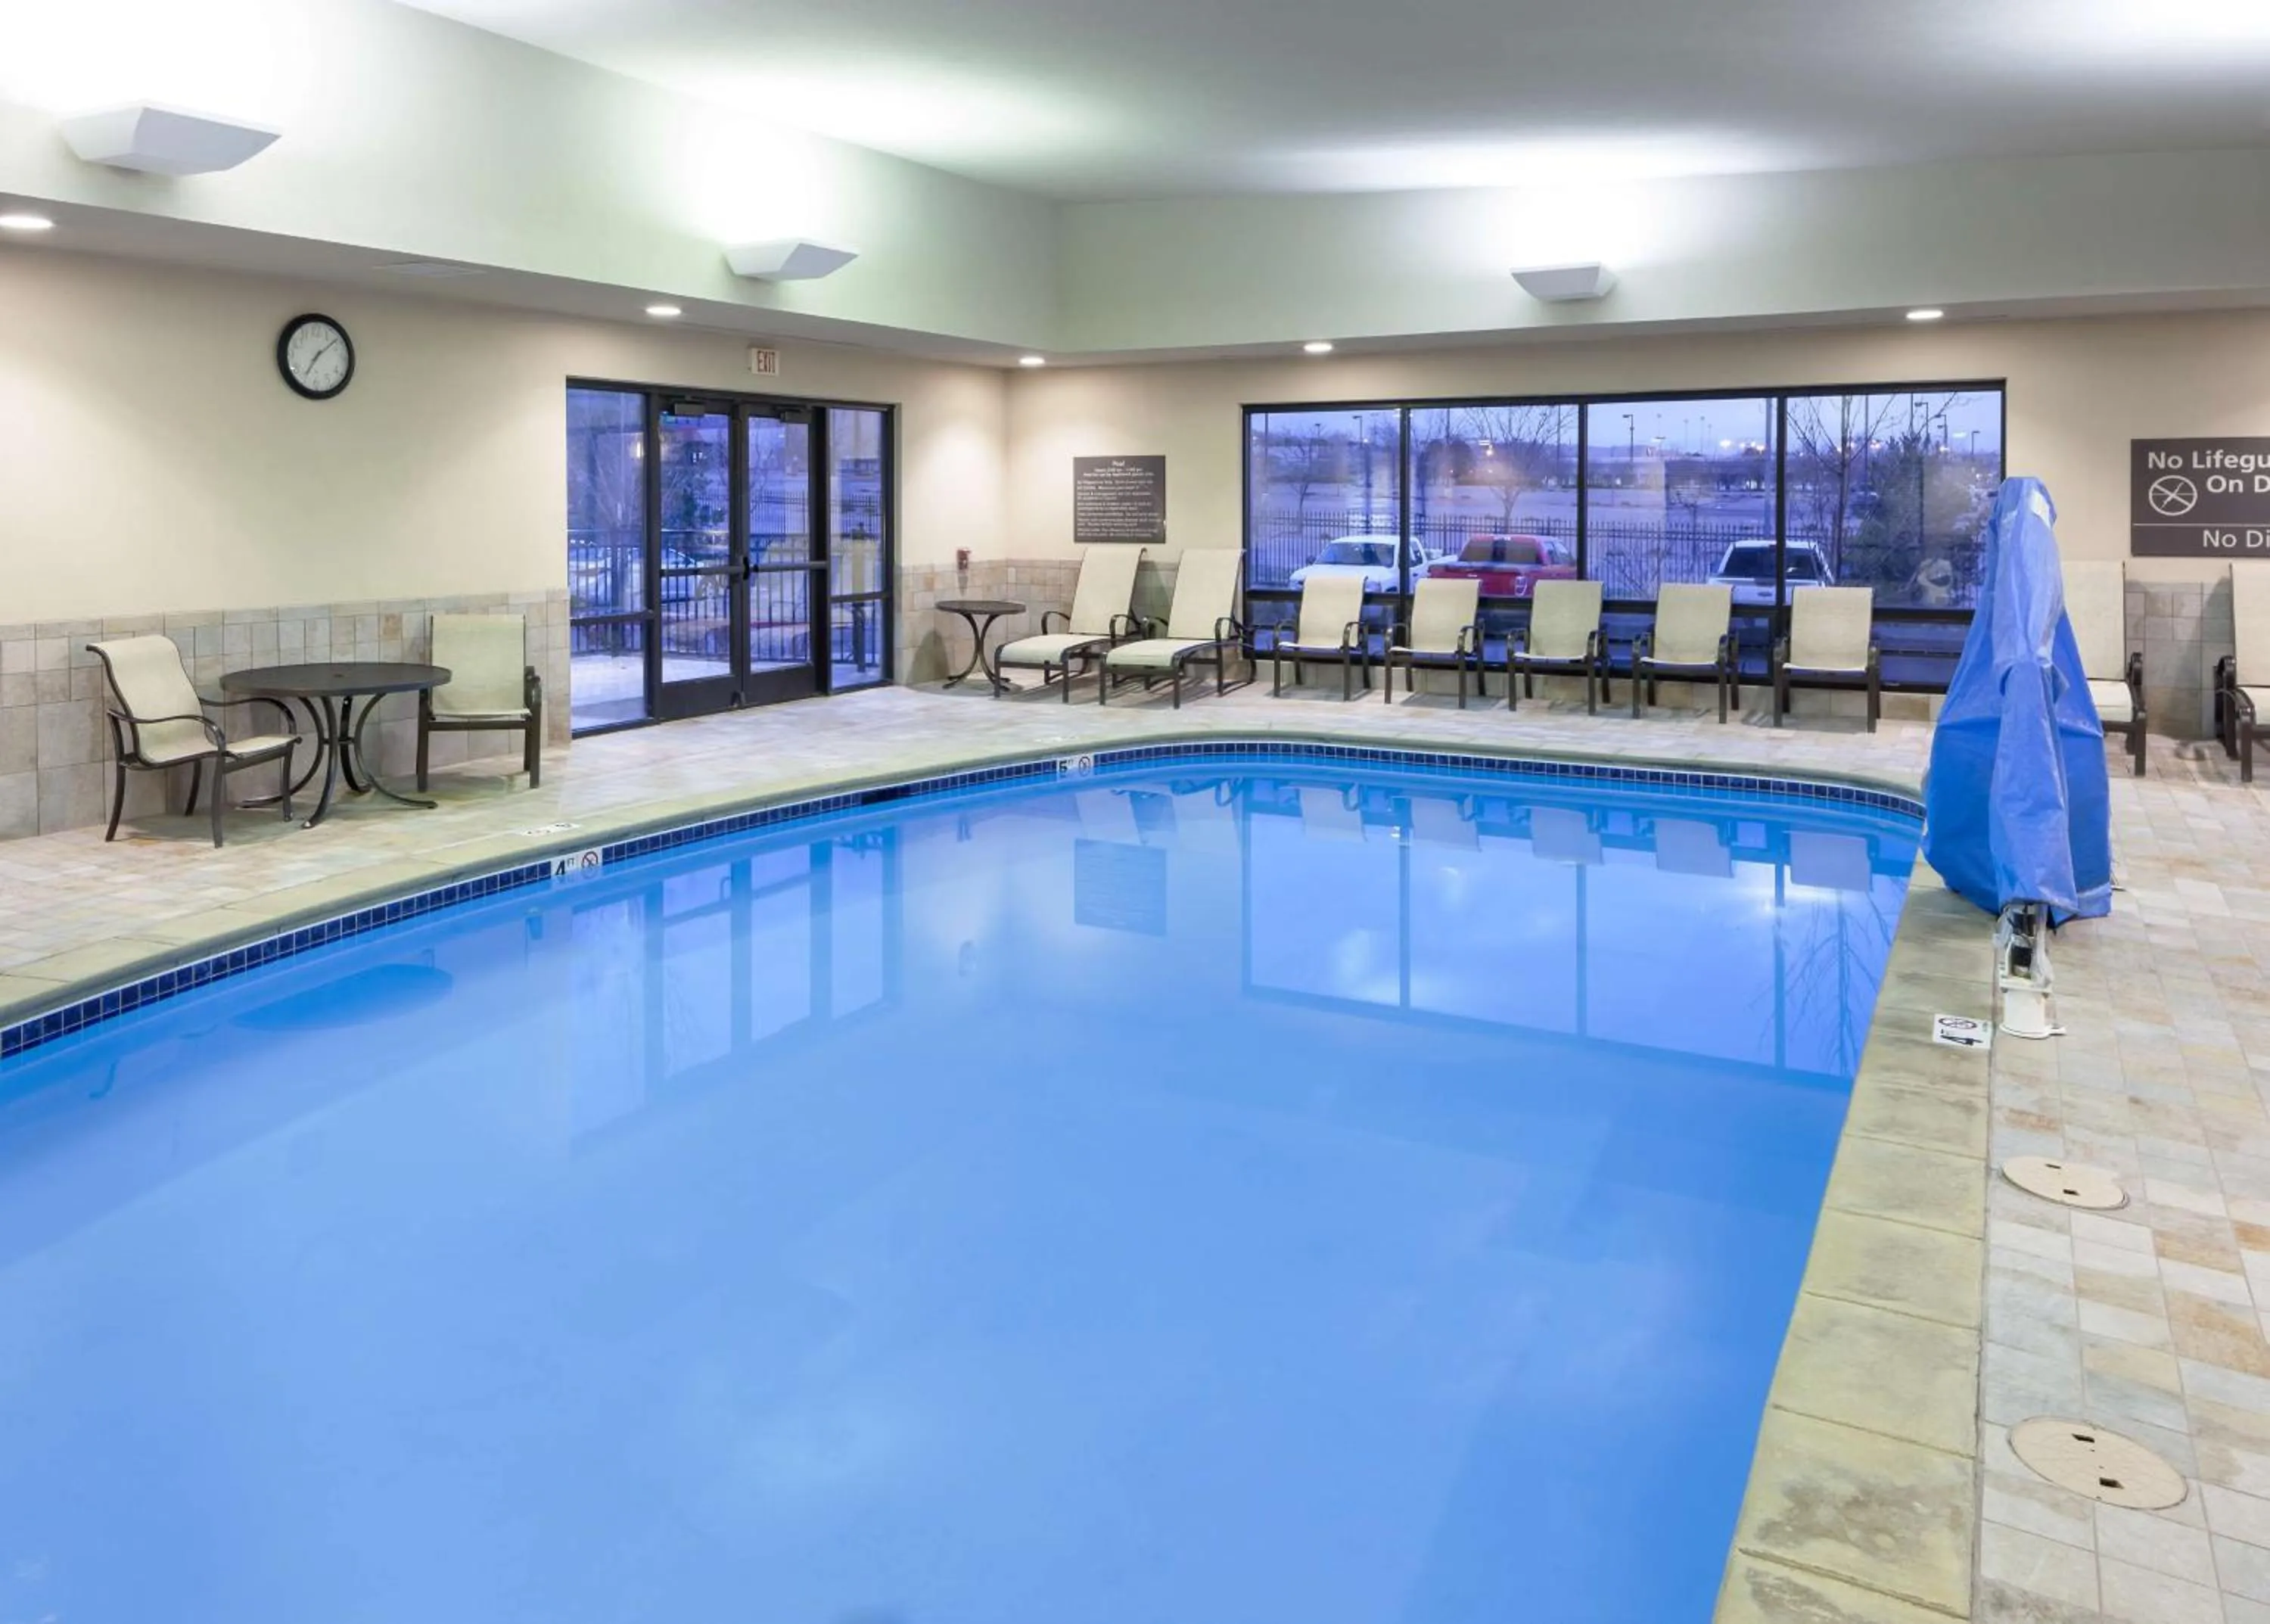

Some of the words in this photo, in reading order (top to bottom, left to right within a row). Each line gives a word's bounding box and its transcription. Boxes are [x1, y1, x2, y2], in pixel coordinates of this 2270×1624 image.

[757, 350, 775, 373] EXIT
[2148, 452, 2183, 469] No
[2192, 450, 2270, 473] Lifegu
[2206, 474, 2244, 493] On
[2203, 529, 2237, 548] No
[555, 860, 565, 876] 4
